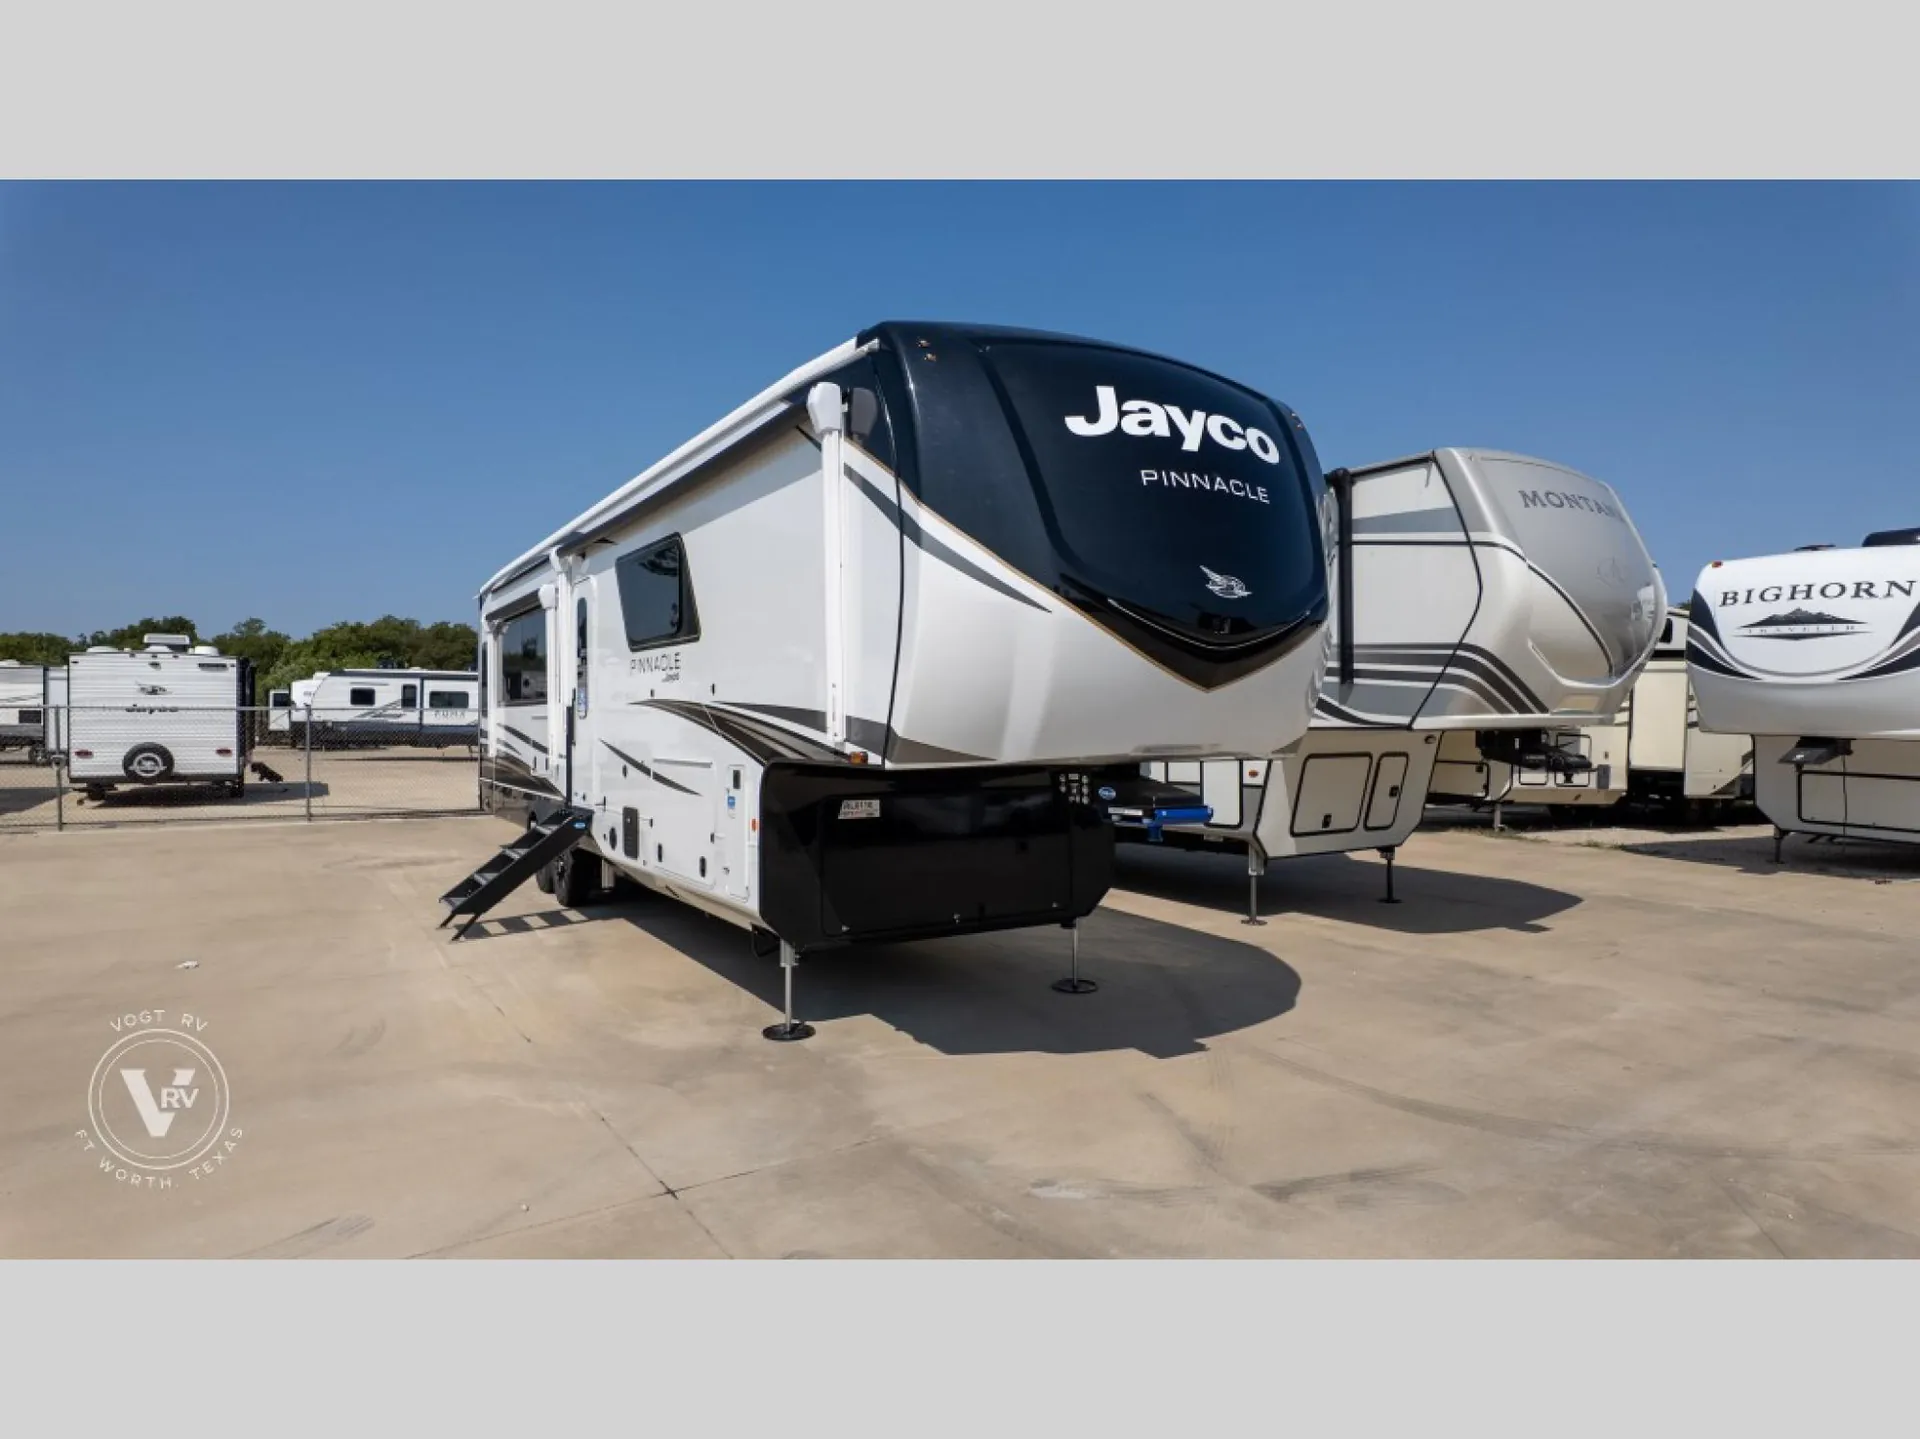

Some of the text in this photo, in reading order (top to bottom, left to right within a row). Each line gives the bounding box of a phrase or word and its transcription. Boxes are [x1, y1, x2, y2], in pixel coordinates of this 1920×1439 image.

[1064, 385, 1280, 464] Jayco
[1140, 469, 1270, 504] PINNACLE
[1518, 490, 1624, 522] MONTAN
[1719, 580, 1916, 607] BIGHORN
[630, 652, 681, 676] PINNACLE
